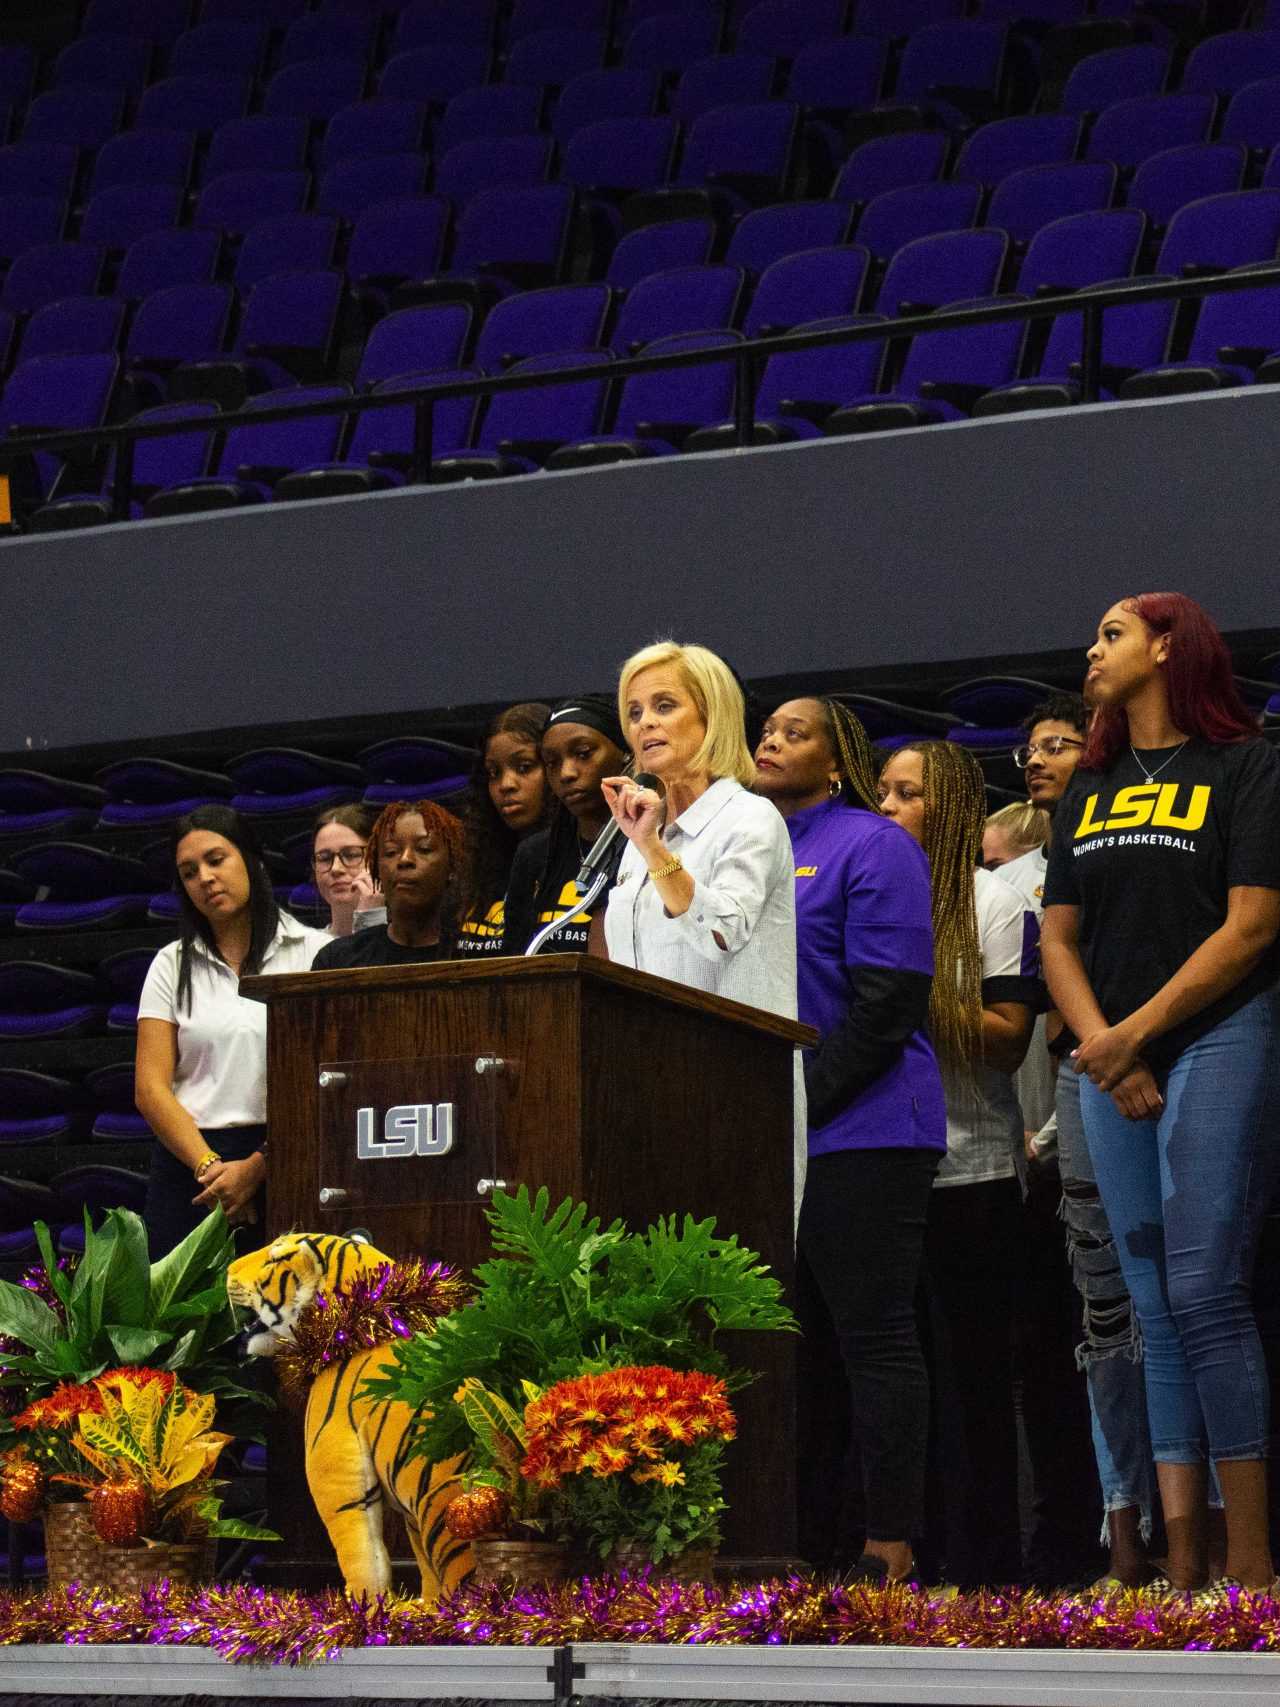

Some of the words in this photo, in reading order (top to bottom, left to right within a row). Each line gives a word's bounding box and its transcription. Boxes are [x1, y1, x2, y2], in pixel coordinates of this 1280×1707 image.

[1073, 783, 1211, 839] LSU
[1072, 835, 1115, 857] WOMEN'S
[1118, 834, 1196, 852] BASKETBALL
[564, 930, 588, 942] BAS
[357, 1103, 453, 1160] LSU
